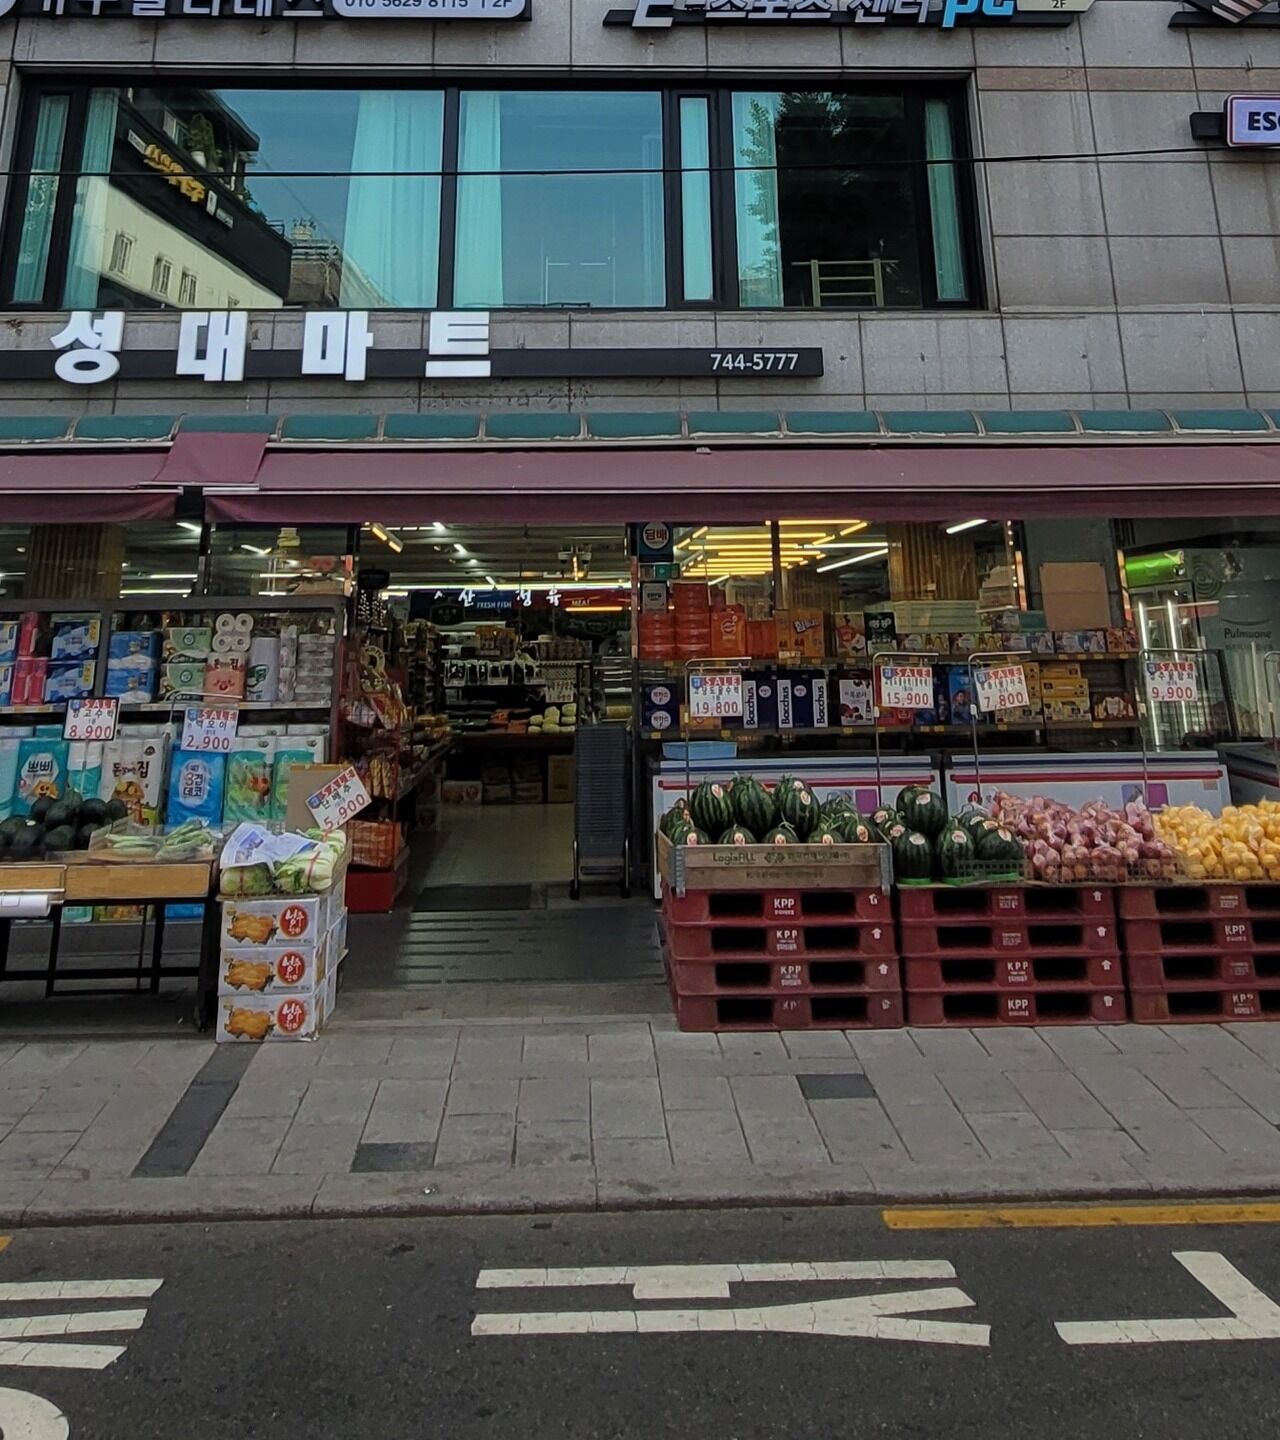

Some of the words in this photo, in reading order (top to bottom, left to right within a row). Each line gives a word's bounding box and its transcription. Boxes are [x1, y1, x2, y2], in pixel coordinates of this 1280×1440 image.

[50, 308, 493, 385] 성대마트
[708, 351, 800, 372] 744-5777
[644, 526, 668, 541] 담배
[1224, 627, 1273, 640] Pulmuone
[886, 691, 929, 706] 15,900
[983, 691, 1024, 710] 7,800
[1151, 686, 1194, 702] 9,900
[695, 701, 739, 716] 19,800
[745, 686, 756, 727] Bacchus
[780, 686, 791, 727] Bacchus
[815, 684, 826, 726] Bacchus
[185, 734, 230, 751] 2,900
[323, 793, 366, 831] 5,900
[773, 897, 796, 909] KPP
[776, 929, 799, 940] KPP
[1225, 924, 1247, 936] KPP
[780, 964, 803, 975] KPP
[1007, 961, 1029, 972] KPP
[1007, 998, 1029, 1011] KPP
